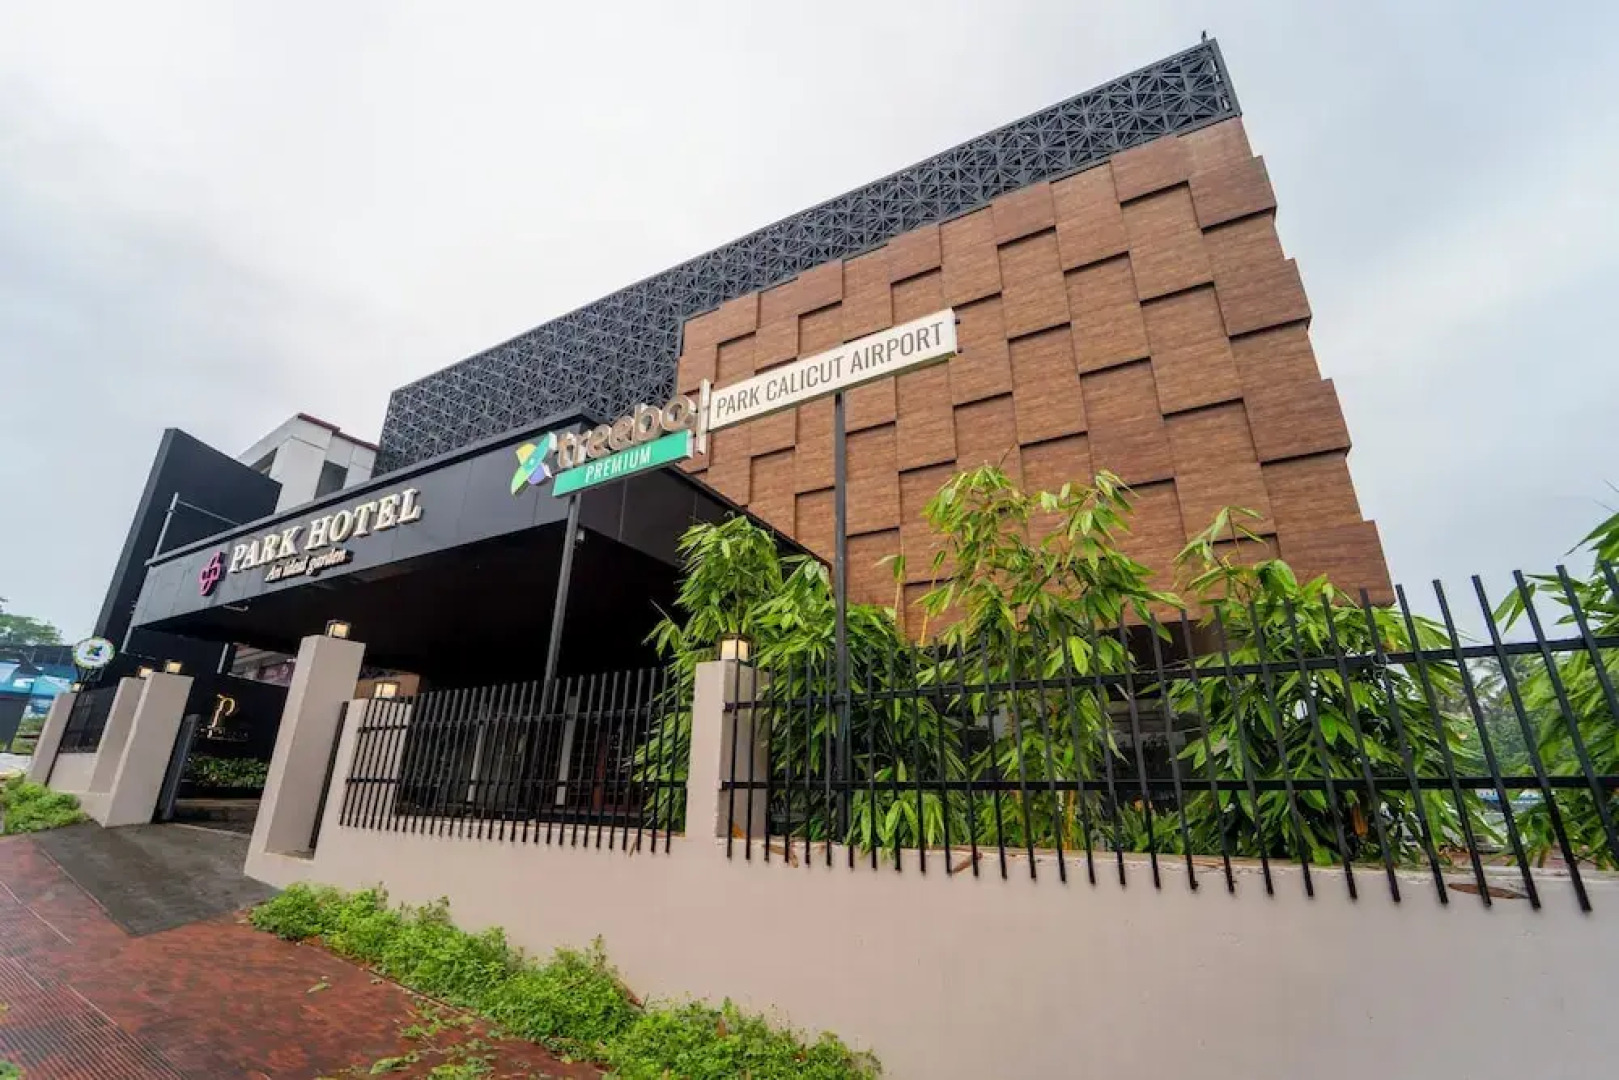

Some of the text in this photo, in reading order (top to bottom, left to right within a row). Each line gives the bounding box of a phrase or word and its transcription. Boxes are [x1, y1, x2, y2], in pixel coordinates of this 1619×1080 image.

[716, 321, 944, 418] PARK CALICUT AIRPORT
[557, 394, 694, 469] treebo
[585, 446, 652, 484] PREMIUM
[228, 488, 423, 574] PARK HOTEL
